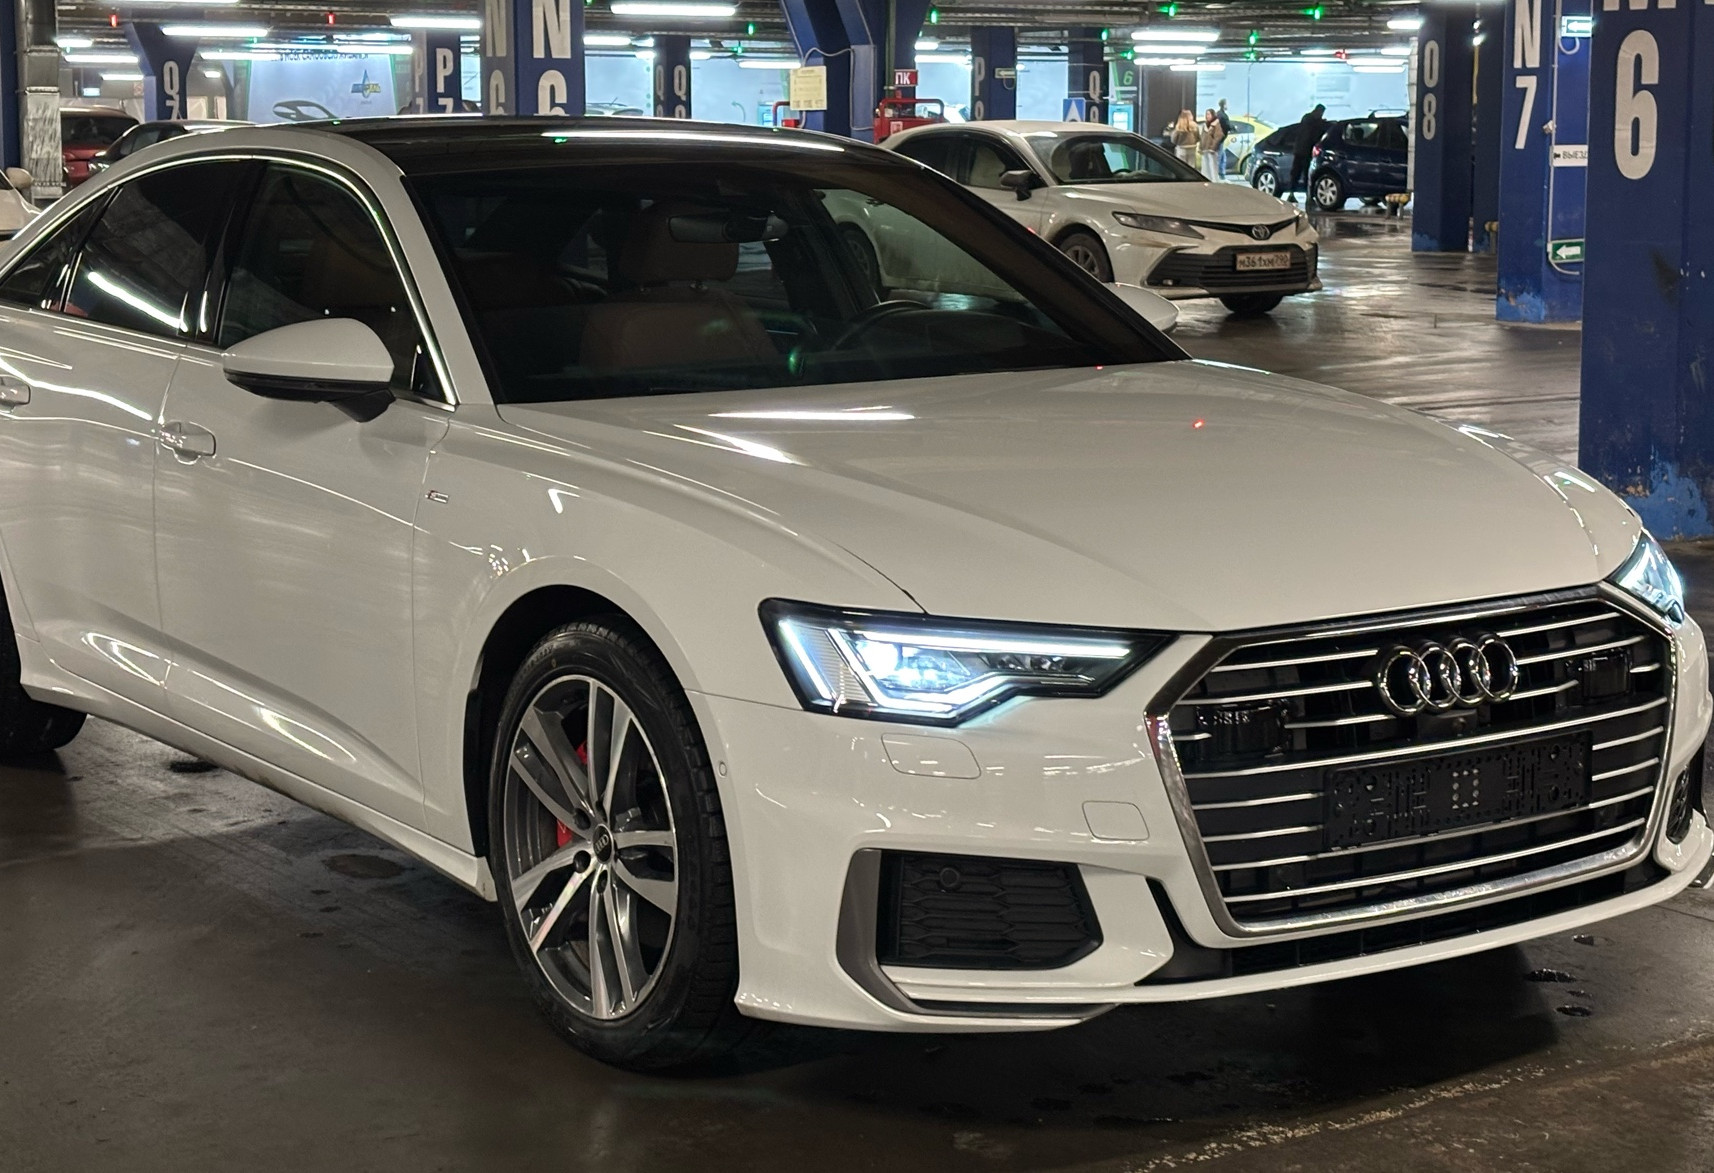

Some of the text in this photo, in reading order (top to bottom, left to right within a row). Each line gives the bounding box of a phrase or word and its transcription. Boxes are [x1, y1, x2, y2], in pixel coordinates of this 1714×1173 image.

[532, 0, 571, 59] N
[1513, 0, 1542, 69] N
[435, 47, 454, 93] P
[673, 64, 687, 101] Q
[894, 71, 912, 86] ПК
[974, 56, 986, 97] P
[1123, 70, 1134, 85] 6
[1422, 92, 1437, 140] 8
[1514, 75, 1538, 150] 7
[1614, 29, 1660, 180] 6
